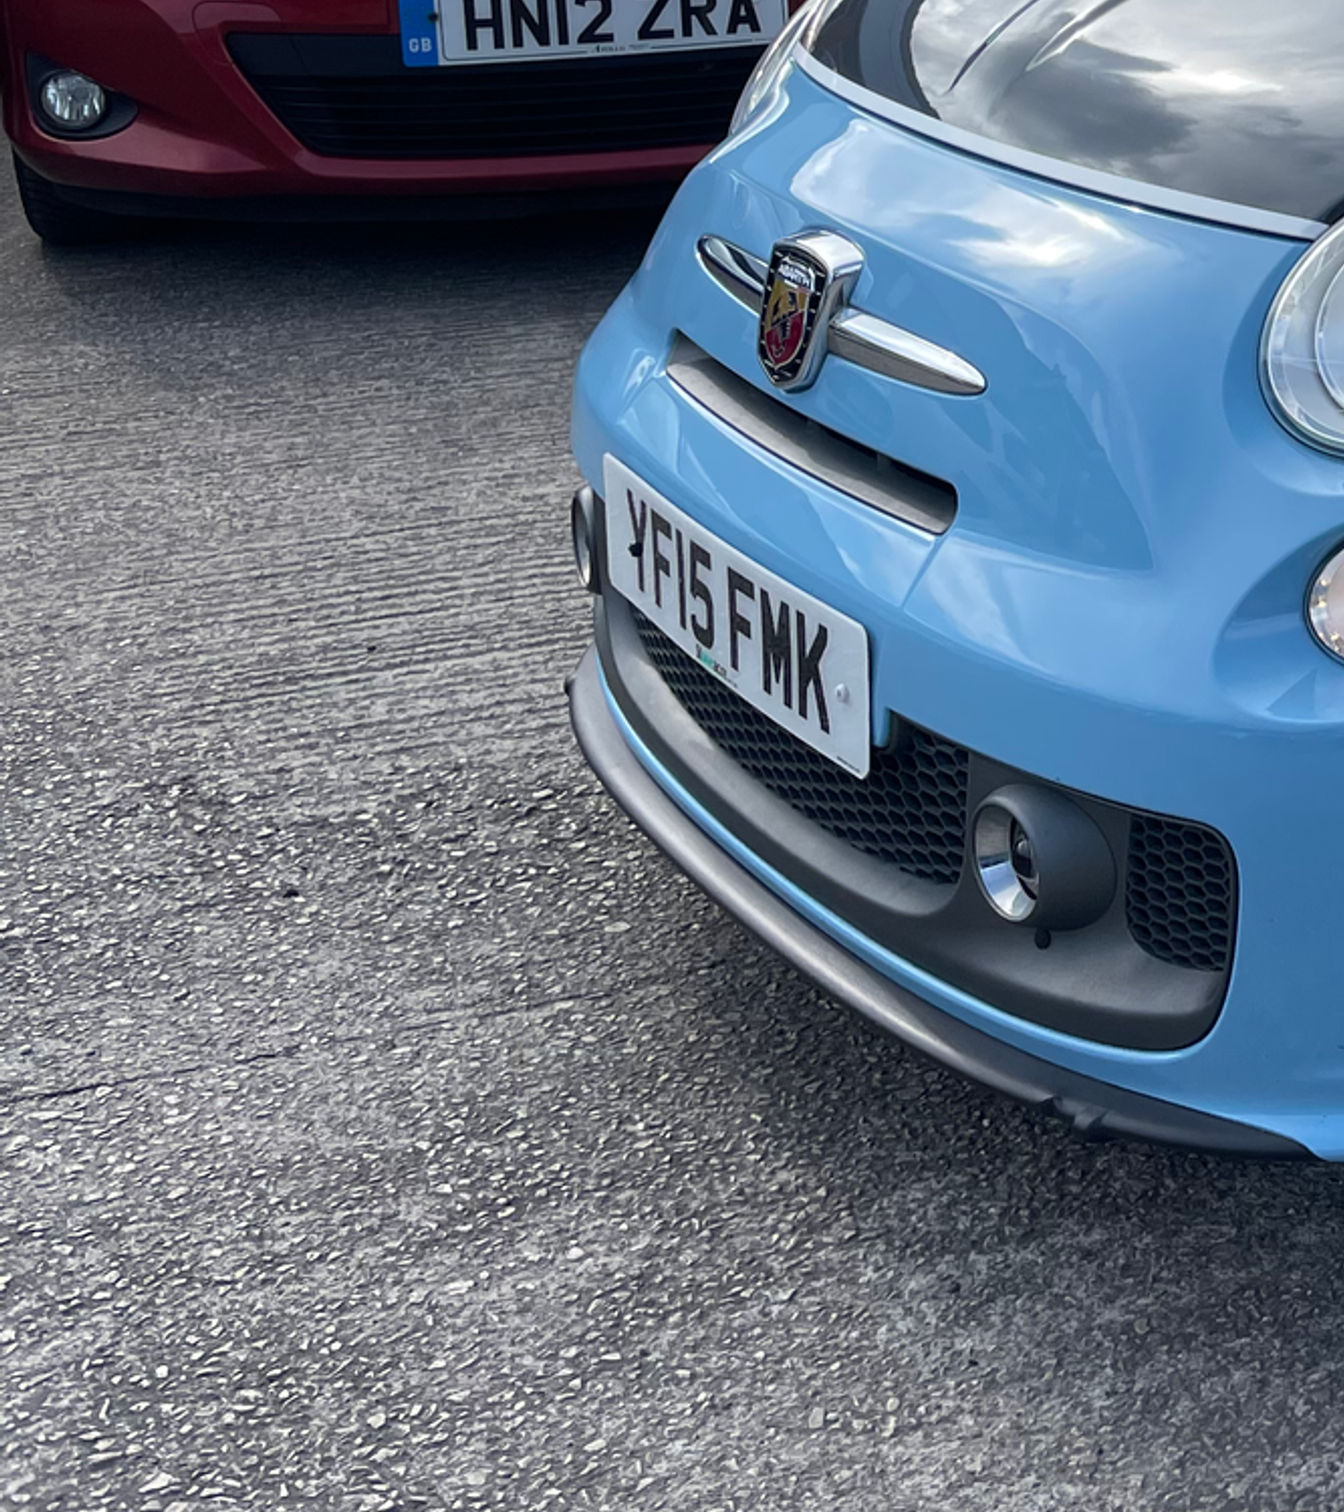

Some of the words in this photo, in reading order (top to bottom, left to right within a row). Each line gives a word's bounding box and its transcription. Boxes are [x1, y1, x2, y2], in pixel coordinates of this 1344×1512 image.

[408, 37, 432, 53] GB
[626, 488, 715, 650] YF15
[727, 566, 830, 735] FMK
